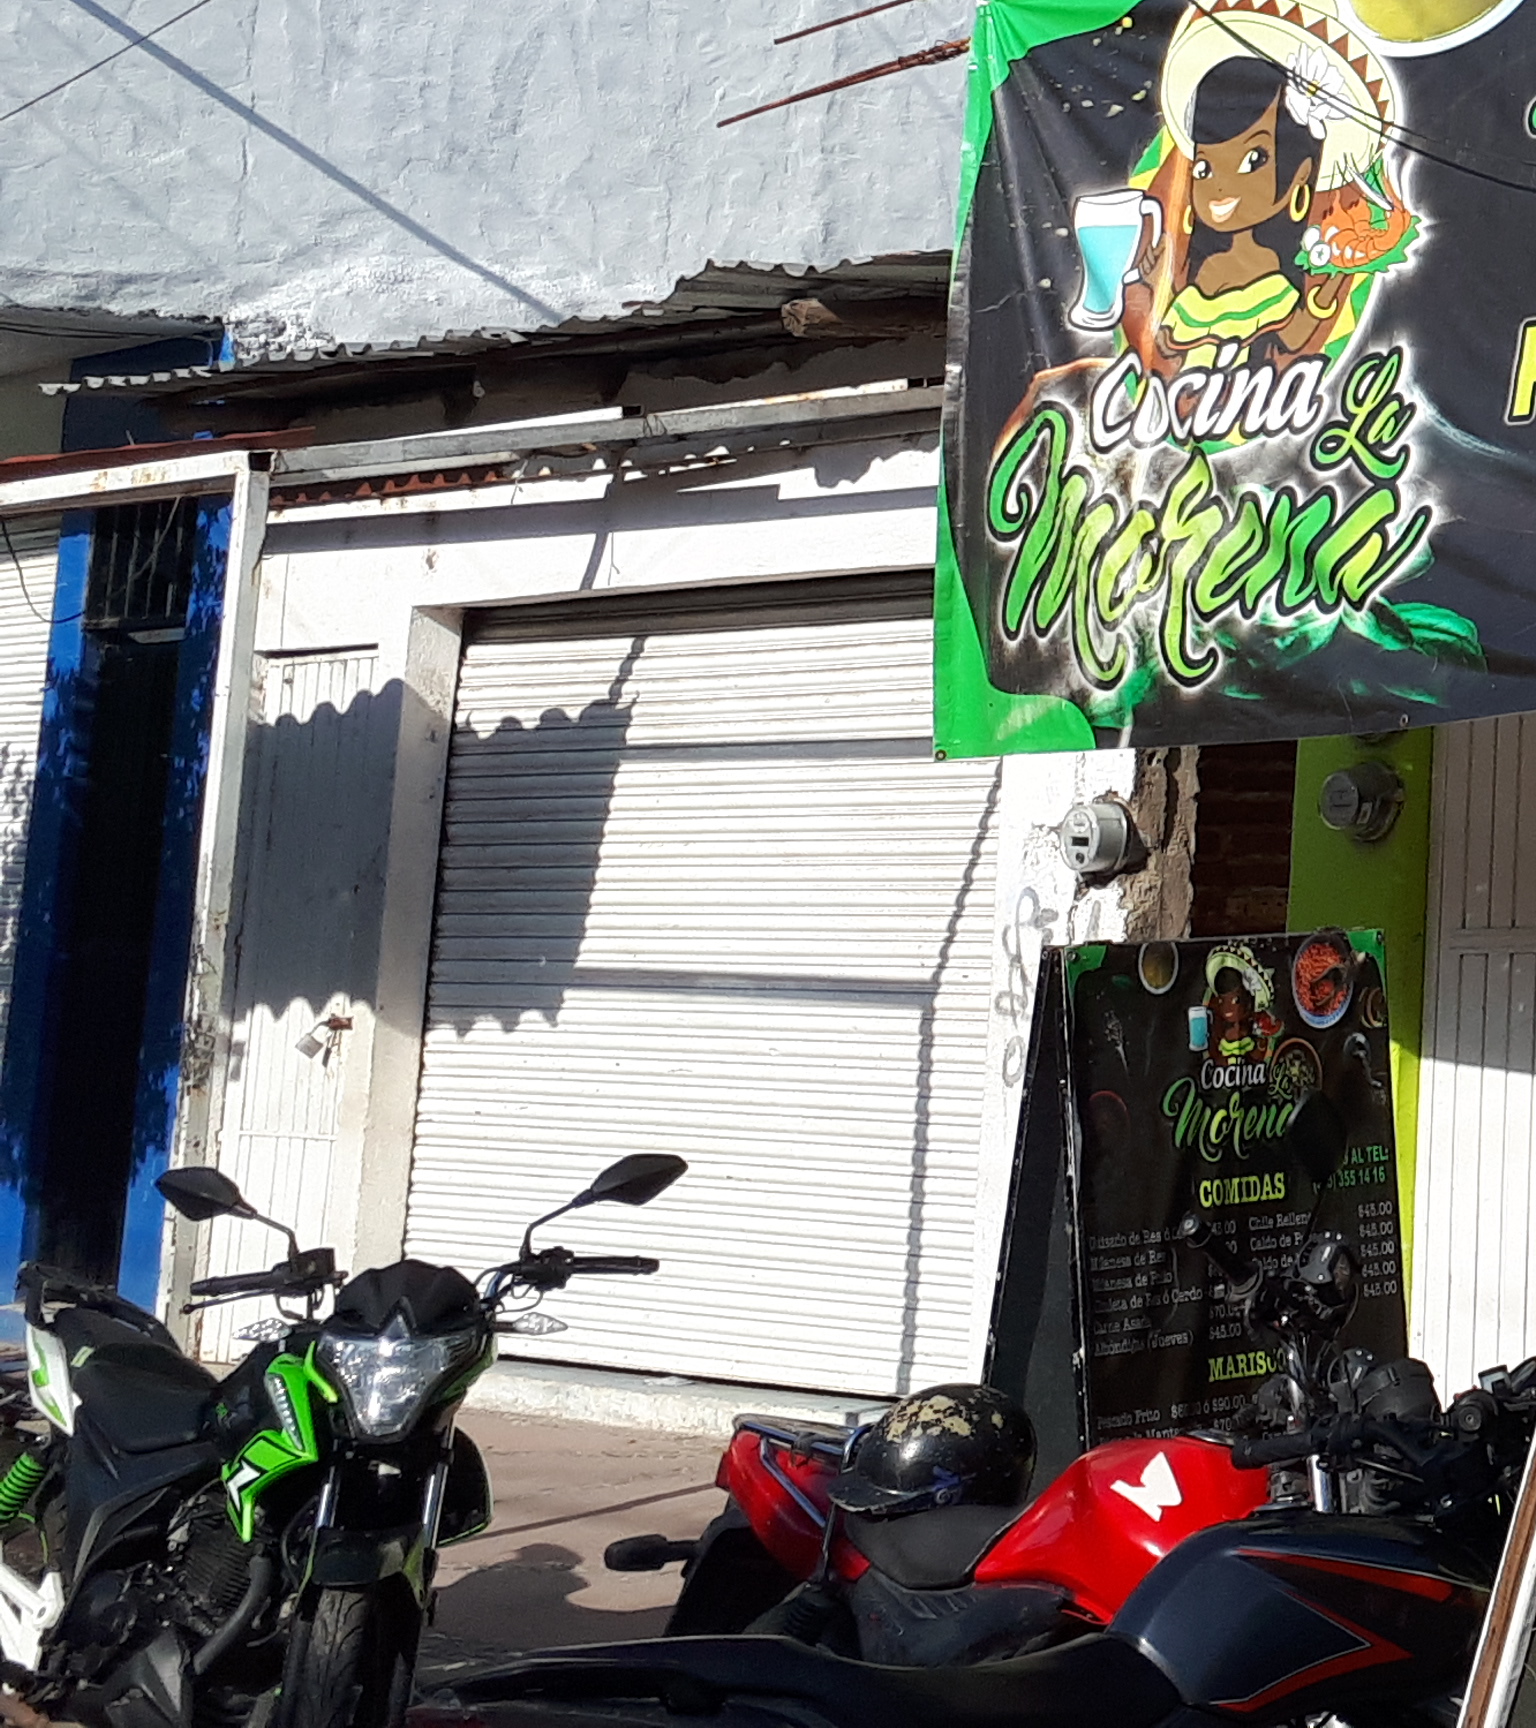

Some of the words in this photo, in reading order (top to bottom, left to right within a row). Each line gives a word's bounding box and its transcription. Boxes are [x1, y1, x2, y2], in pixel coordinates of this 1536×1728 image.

[1090, 344, 1326, 450] Cocina
[1312, 346, 1416, 477] La
[988, 404, 1432, 688] Morena
[1200, 1056, 1267, 1090] Cocina
[1267, 1062, 1294, 1100] La
[1350, 1146, 1365, 1165] AL
[1366, 1144, 1390, 1163] TEL:
[1337, 1168, 1357, 1188] 355
[1198, 1170, 1287, 1210] COMIDAS
[1275, 1212, 1312, 1228] Rellen
[1128, 1231, 1141, 1246] de
[1279, 1233, 1292, 1248] de
[1133, 1252, 1146, 1267] de
[1280, 1253, 1294, 1268] de
[1134, 1273, 1149, 1287] de
[1129, 1294, 1144, 1308] de
